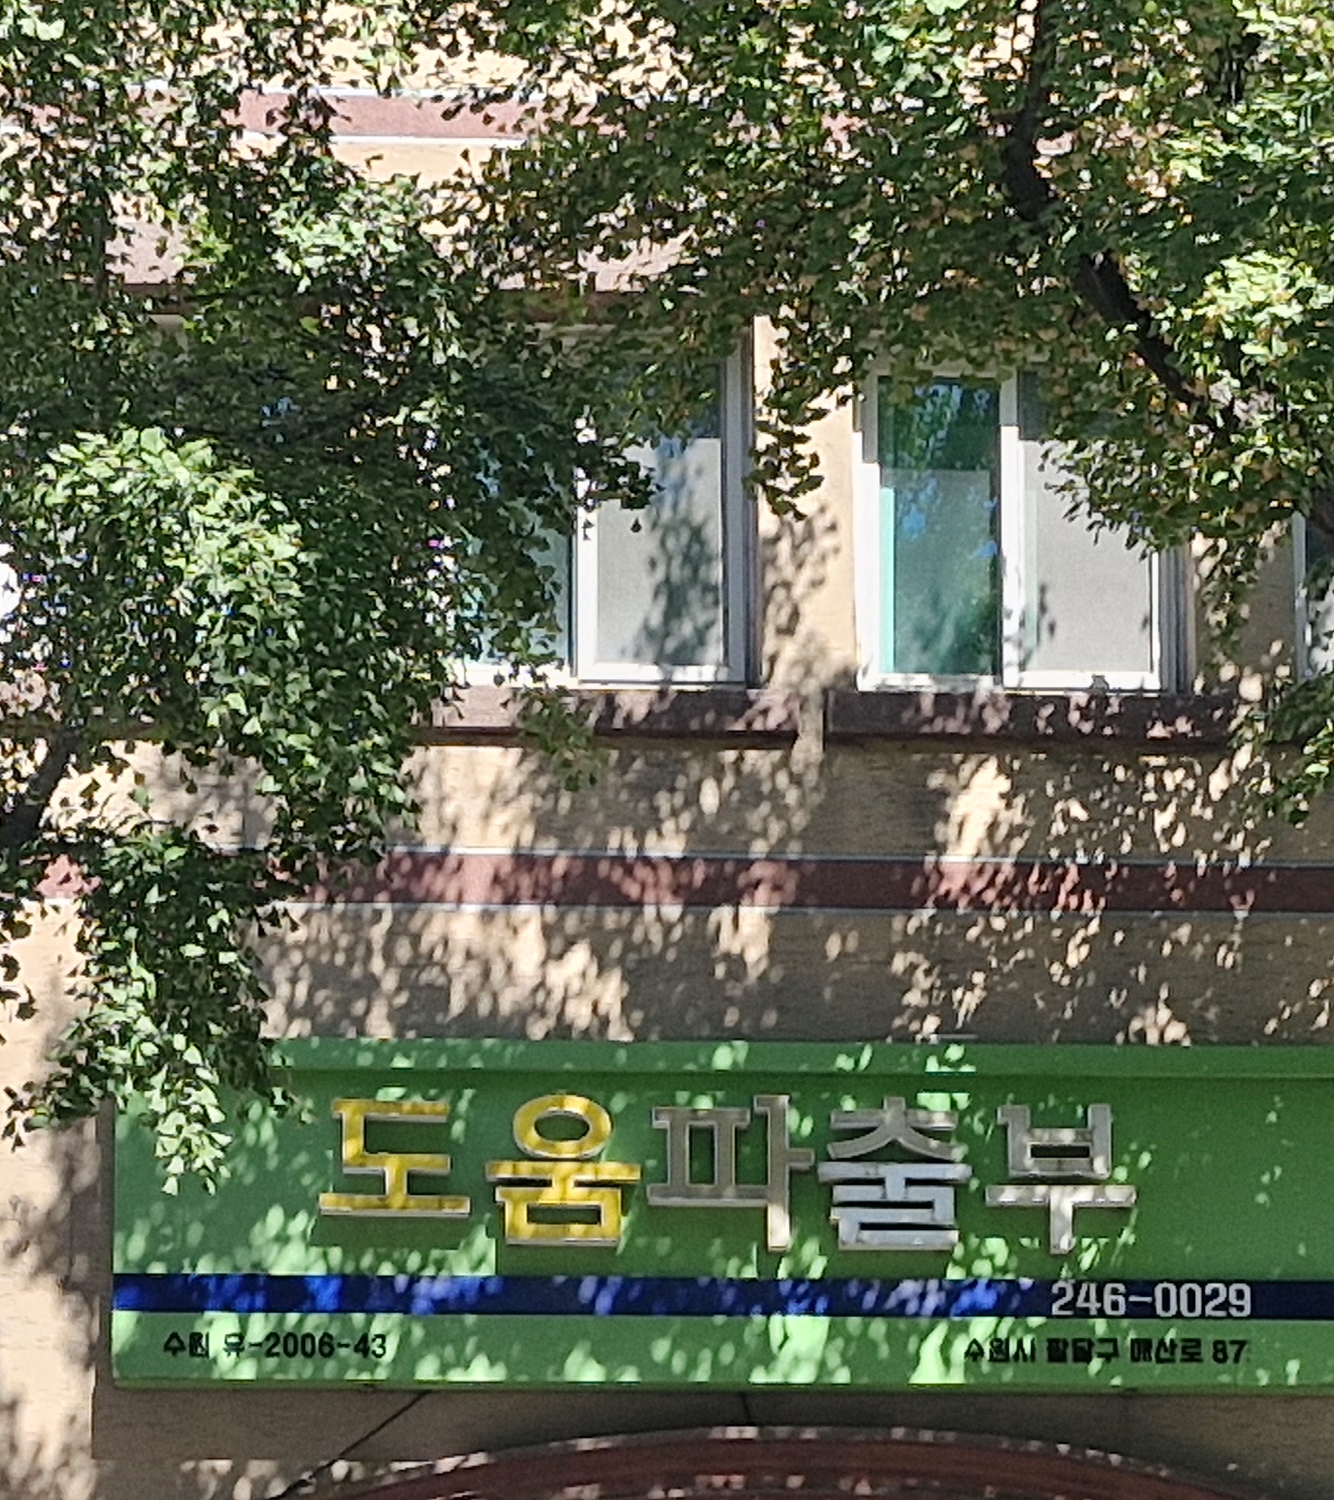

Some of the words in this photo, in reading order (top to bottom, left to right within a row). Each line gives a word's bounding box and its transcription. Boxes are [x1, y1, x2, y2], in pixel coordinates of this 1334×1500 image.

[318, 1094, 1136, 1253] 도움파출부
[1052, 1281, 1252, 1318] 246-0029
[163, 1331, 210, 1359] 수원
[964, 1337, 1036, 1364] 수원시
[1046, 1336, 1120, 1364] 팔달구
[1130, 1337, 1204, 1364] 매산로
[1212, 1339, 1248, 1364] 87
